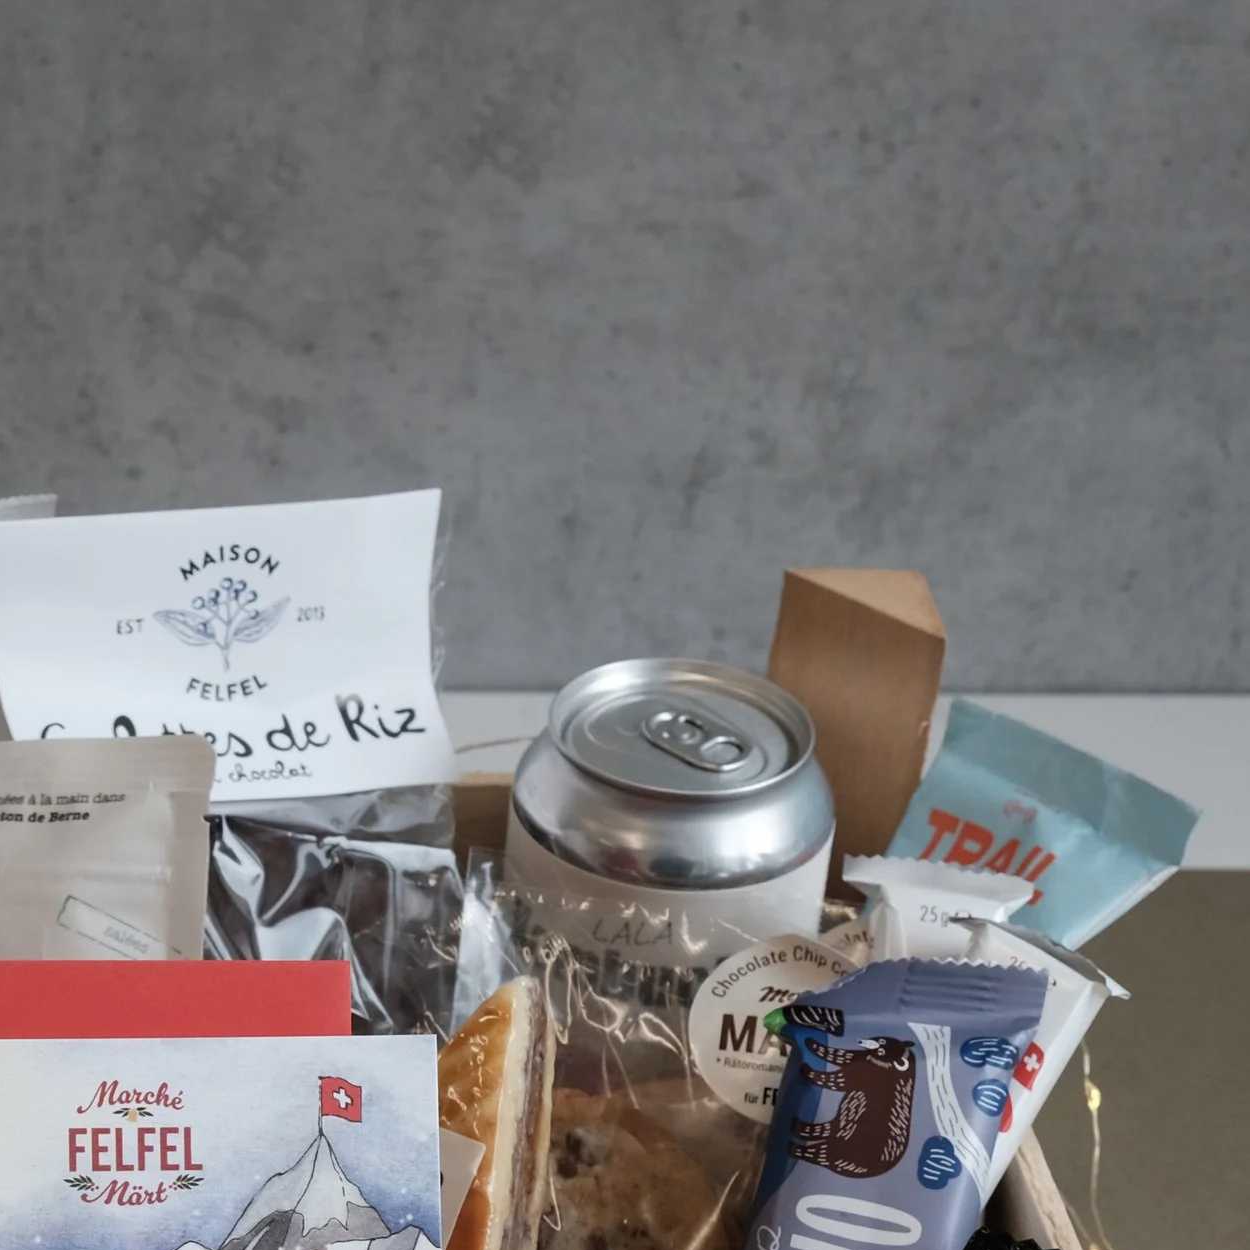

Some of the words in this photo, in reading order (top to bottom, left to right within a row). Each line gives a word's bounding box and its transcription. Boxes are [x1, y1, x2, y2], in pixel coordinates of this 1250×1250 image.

[178, 544, 281, 581] MAISON
[116, 618, 145, 635] EST
[185, 675, 268, 701] FELFEL
[265, 713, 331, 751] de
[336, 694, 426, 743] Riz
[228, 760, 313, 784] chocolat
[39, 793, 52, 805] la
[56, 792, 89, 804] main
[92, 792, 126, 804] dans
[27, 811, 45, 823] de
[49, 810, 90, 823] Berne
[593, 917, 674, 946] LALA
[711, 949, 788, 998] Chocolate
[792, 944, 827, 969] Chip
[76, 1080, 184, 1114] Marché
[68, 1127, 204, 1172] FELFEL
[80, 1179, 169, 1206] Märt
